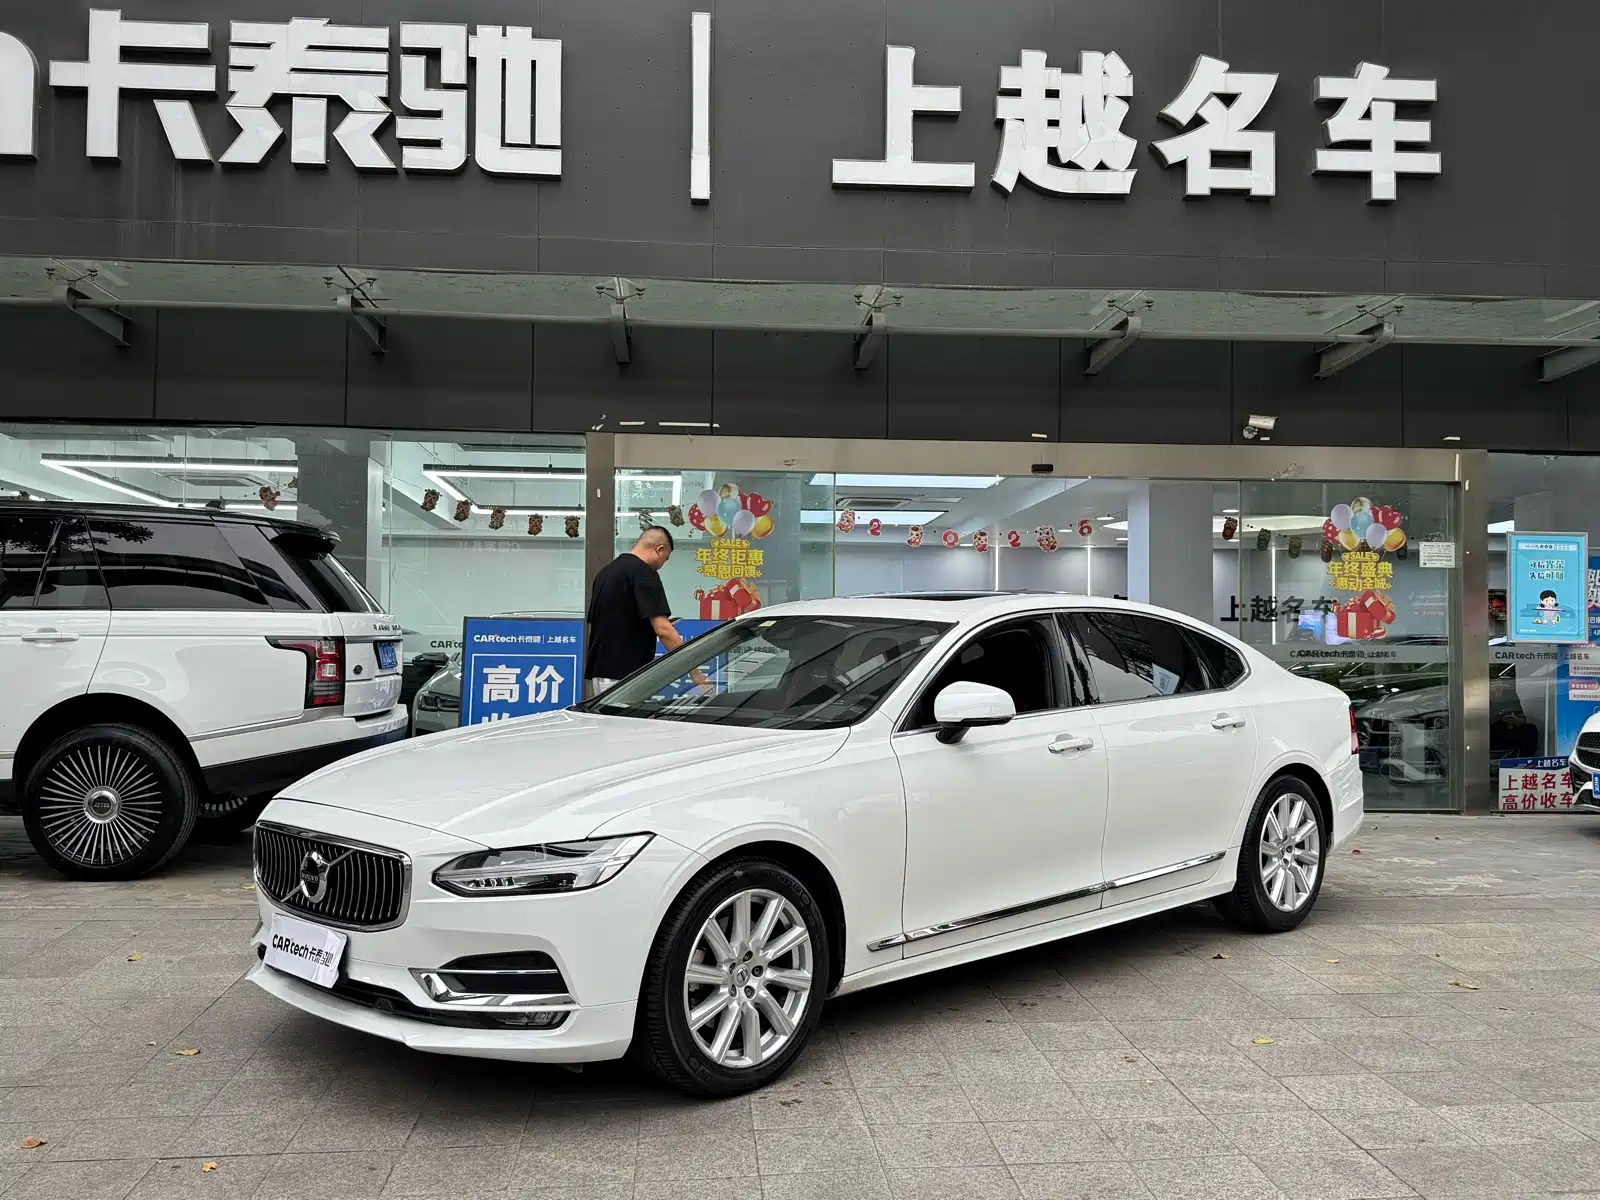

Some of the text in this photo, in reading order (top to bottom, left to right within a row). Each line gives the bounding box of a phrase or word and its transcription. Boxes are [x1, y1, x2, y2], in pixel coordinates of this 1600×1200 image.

[49, 8, 562, 179] 卡泰驰
[830, 44, 1442, 202] 上越名车
[720, 538, 741, 547] SALE
[1350, 551, 1372, 560] SALE
[704, 564, 757, 579] 感恩回馈
[1327, 561, 1393, 578] 年终盛典
[1336, 577, 1387, 591] 惠动全城
[473, 634, 517, 643] CARtech
[546, 635, 577, 644] 上越名车
[1495, 651, 1535, 660] CARtech
[482, 664, 565, 704] 高价
[1536, 758, 1567, 768] 上越名车
[1502, 771, 1573, 791] 上越名车
[1502, 791, 1574, 810] 高价收车
[272, 932, 309, 959] CARtech
